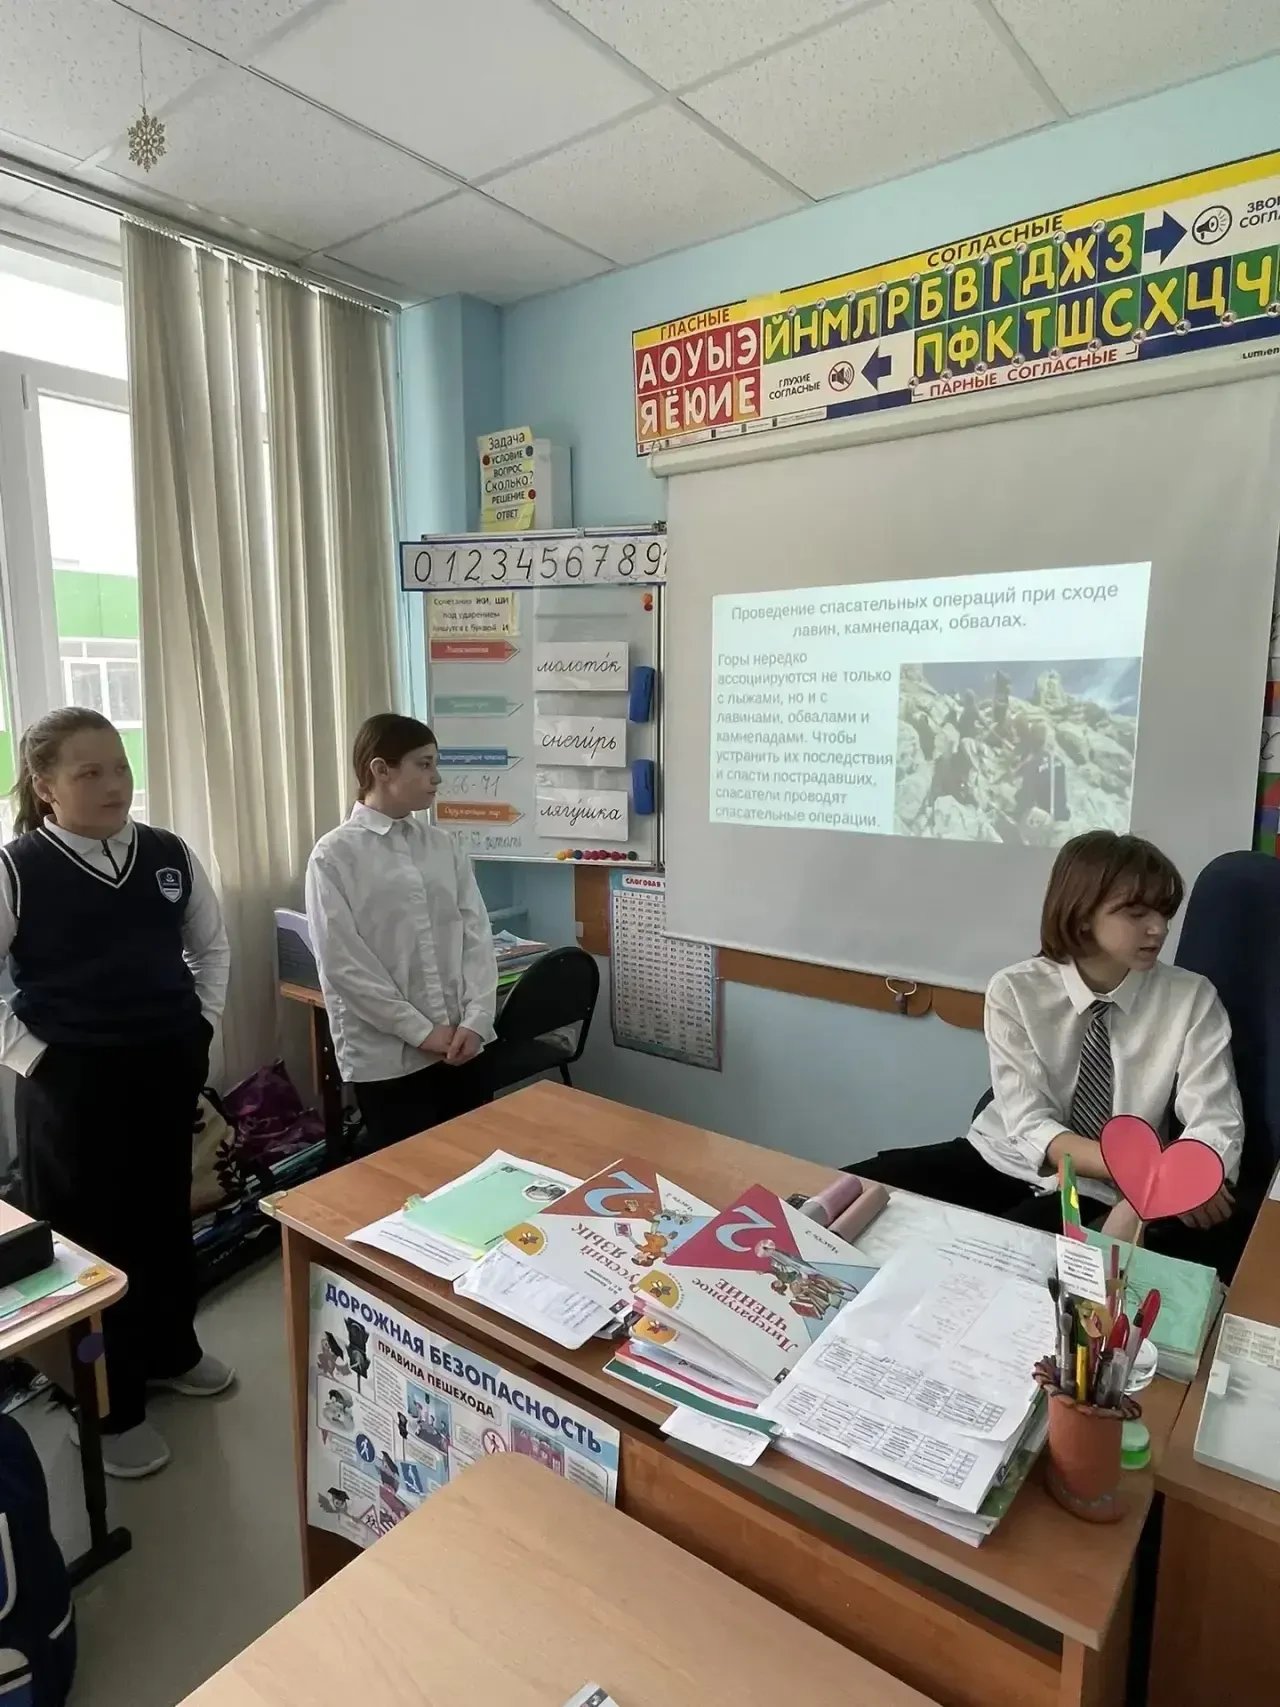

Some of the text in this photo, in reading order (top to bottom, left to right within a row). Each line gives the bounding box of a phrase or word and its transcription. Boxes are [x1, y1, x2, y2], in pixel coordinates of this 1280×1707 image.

[927, 214, 1064, 268] СОГЛАСНЫЕ
[660, 307, 731, 342] ГЛАСНЫЕ
[778, 372, 811, 388] ГЛУХИЕ
[930, 348, 1119, 398] ПАРНЫЕ СОГЛАСНЫЕ
[768, 381, 821, 401] СОГЛАСНЫЕ
[488, 432, 525, 451] Задача
[491, 449, 523, 465] УСЛОВИЕ
[493, 463, 522, 478] ВОПРОС
[485, 470, 534, 493] Сколько?
[491, 490, 525, 505] РЕШЕНИЕ
[496, 508, 518, 520] ОТВЕТ
[731, 584, 1119, 622] Проведение спасательных операций при сходе
[793, 613, 1027, 638] лавин, камнепадах, обвалах.
[718, 652, 808, 669] Горы нередко
[717, 670, 892, 687] ассоциируются не только
[717, 692, 828, 706] с лыжами, но и с
[716, 709, 869, 725] лавинами, обвалами и
[716, 730, 857, 746] камнепадами. Чтобы
[716, 750, 893, 768] устранить их последствия
[716, 769, 877, 786] и спасти пострадавших,
[715, 787, 848, 806] спасатели проводят
[715, 806, 880, 828] спасательные операции.
[625, 877, 661, 888] СЛОГОВАЯ
[584, 1170, 654, 1216] 2
[715, 1205, 777, 1252] 2
[571, 1222, 628, 1259] ЯЗЫК
[692, 1277, 798, 1352] Литературное
[715, 1278, 788, 1333] ЧТЕНИЕ
[326, 1283, 425, 1358] ДОРОЖНАЯ
[429, 1344, 602, 1454] БЕЗОПАСНОСТЬ
[377, 1340, 425, 1381] ПРАВИЛА
[427, 1372, 495, 1420] ПЕШЕХОДА
